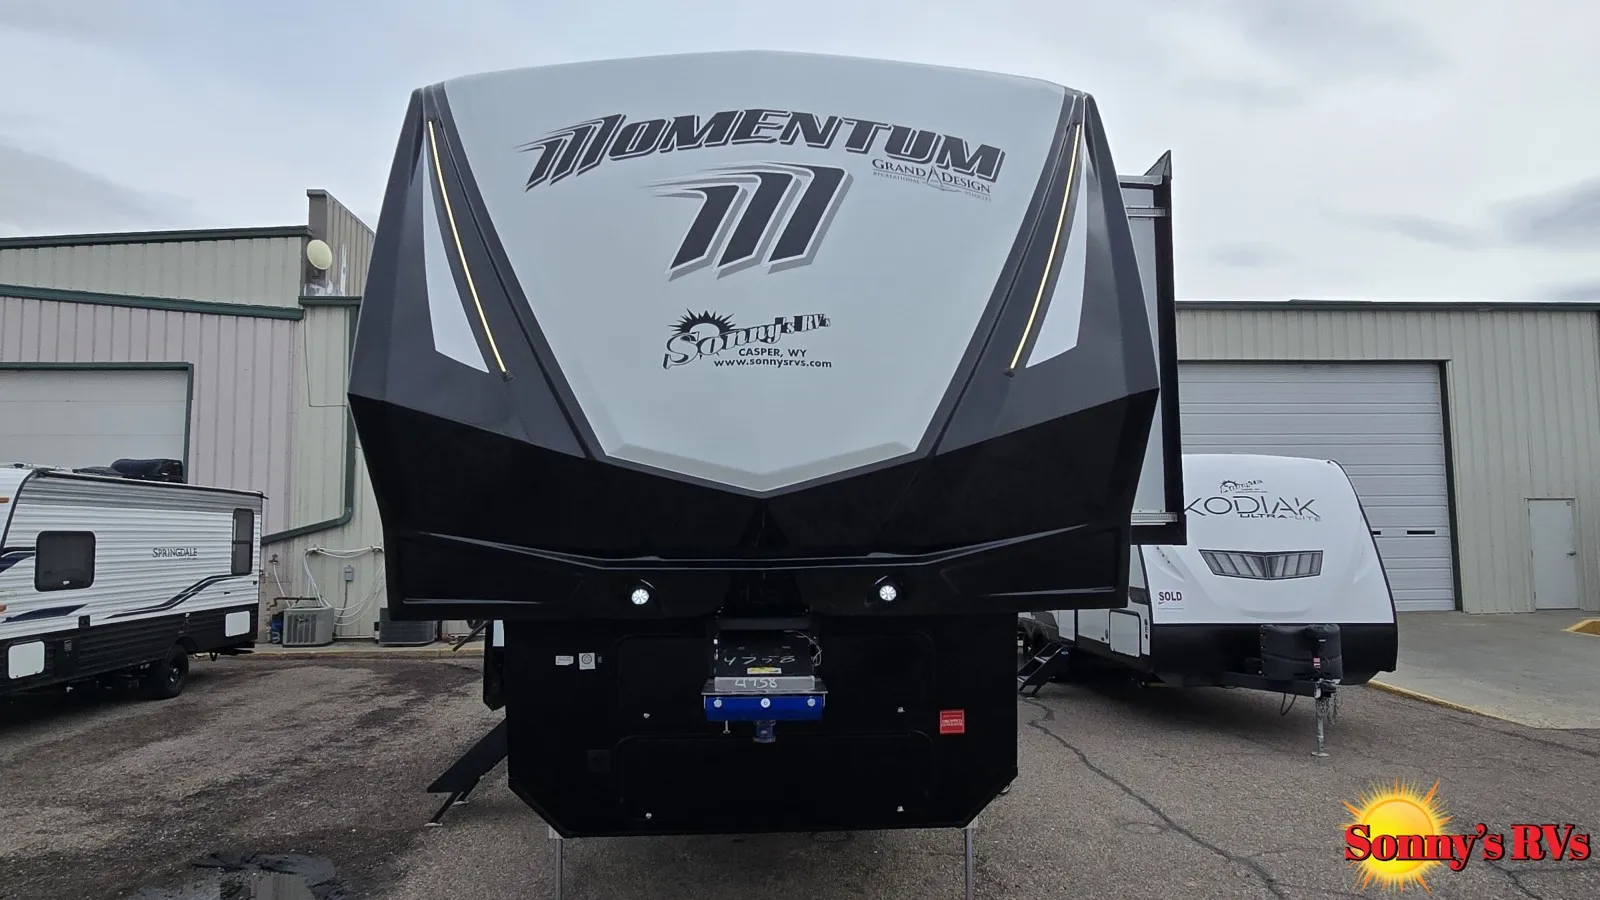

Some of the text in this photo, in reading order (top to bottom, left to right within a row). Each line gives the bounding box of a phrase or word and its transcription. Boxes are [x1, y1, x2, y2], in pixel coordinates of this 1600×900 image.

[514, 108, 1006, 193] MOMENTUM
[872, 158, 991, 194] GRAND DESIGN
[738, 347, 808, 358] CASPER, WY
[713, 357, 832, 369] www.sonnysrvs.com
[1184, 495, 1321, 518] KODIAK
[152, 547, 198, 558] SPRINGDALE
[1158, 591, 1183, 602] SOLD
